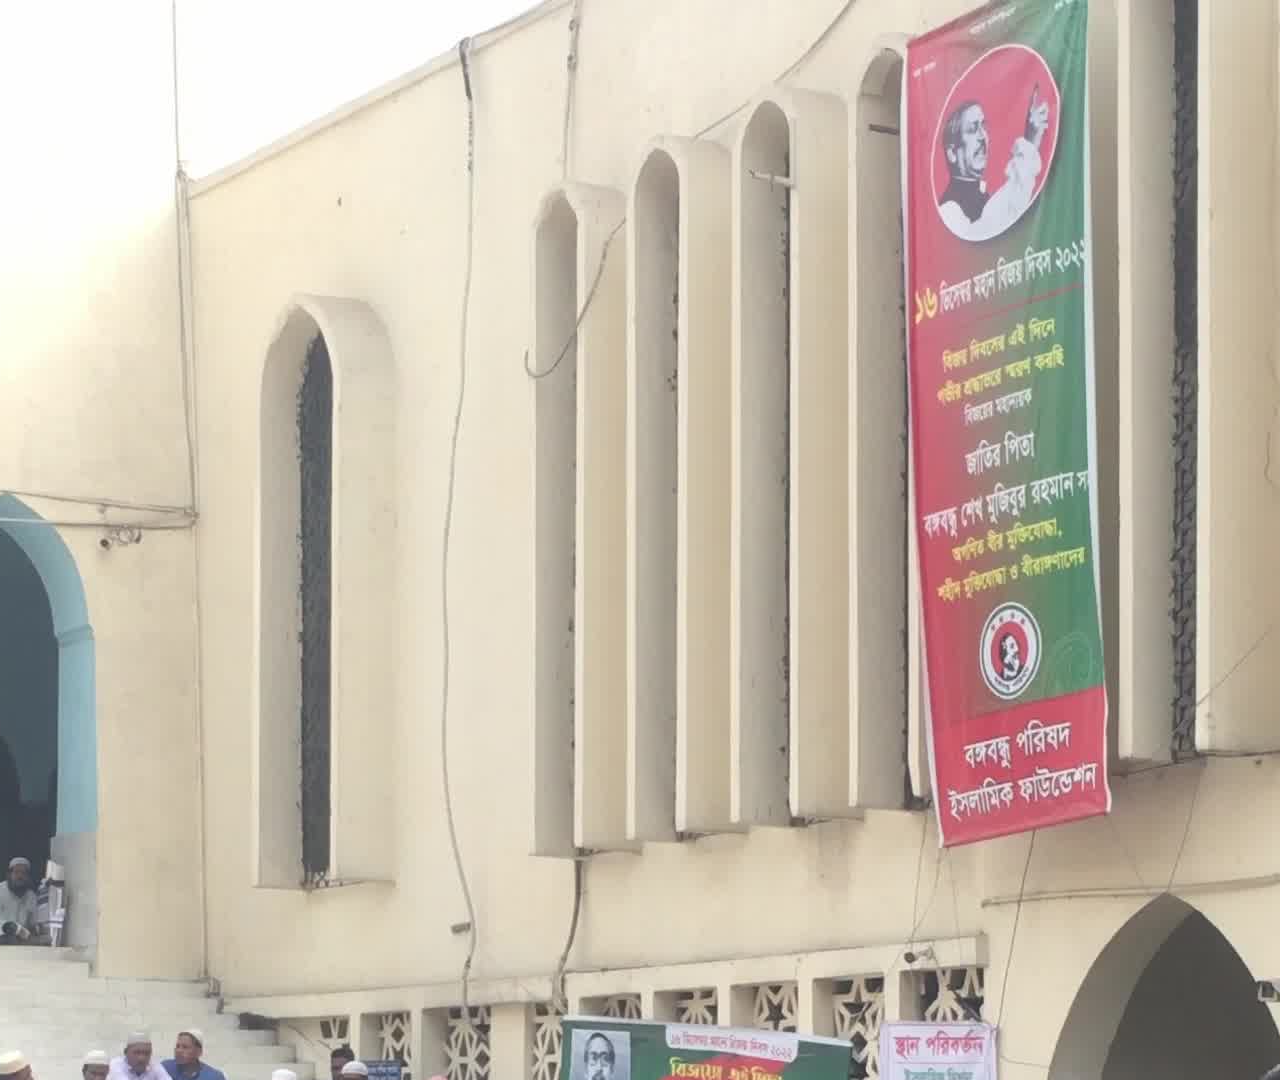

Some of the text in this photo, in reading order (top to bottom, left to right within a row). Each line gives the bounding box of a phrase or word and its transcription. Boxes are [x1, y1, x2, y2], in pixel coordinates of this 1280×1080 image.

[997, 256, 1023, 290] বিজয়
[1024, 246, 1051, 280] দিবস
[965, 430, 1035, 475] জাতির পিতা
[923, 506, 957, 539] বঙ্গবন্ধু
[961, 497, 983, 528] শেখ
[986, 482, 1027, 524] মুজিবুর
[1029, 472, 1074, 505] রহমান
[1009, 564, 1018, 579] ও
[963, 720, 1072, 769] বঙ্গবন্ধু পরিষদ
[948, 761, 1098, 822] ইসলামিক ফাউন্ডেশন
[893, 1028, 985, 1060] স্থান পরিবর্তন
